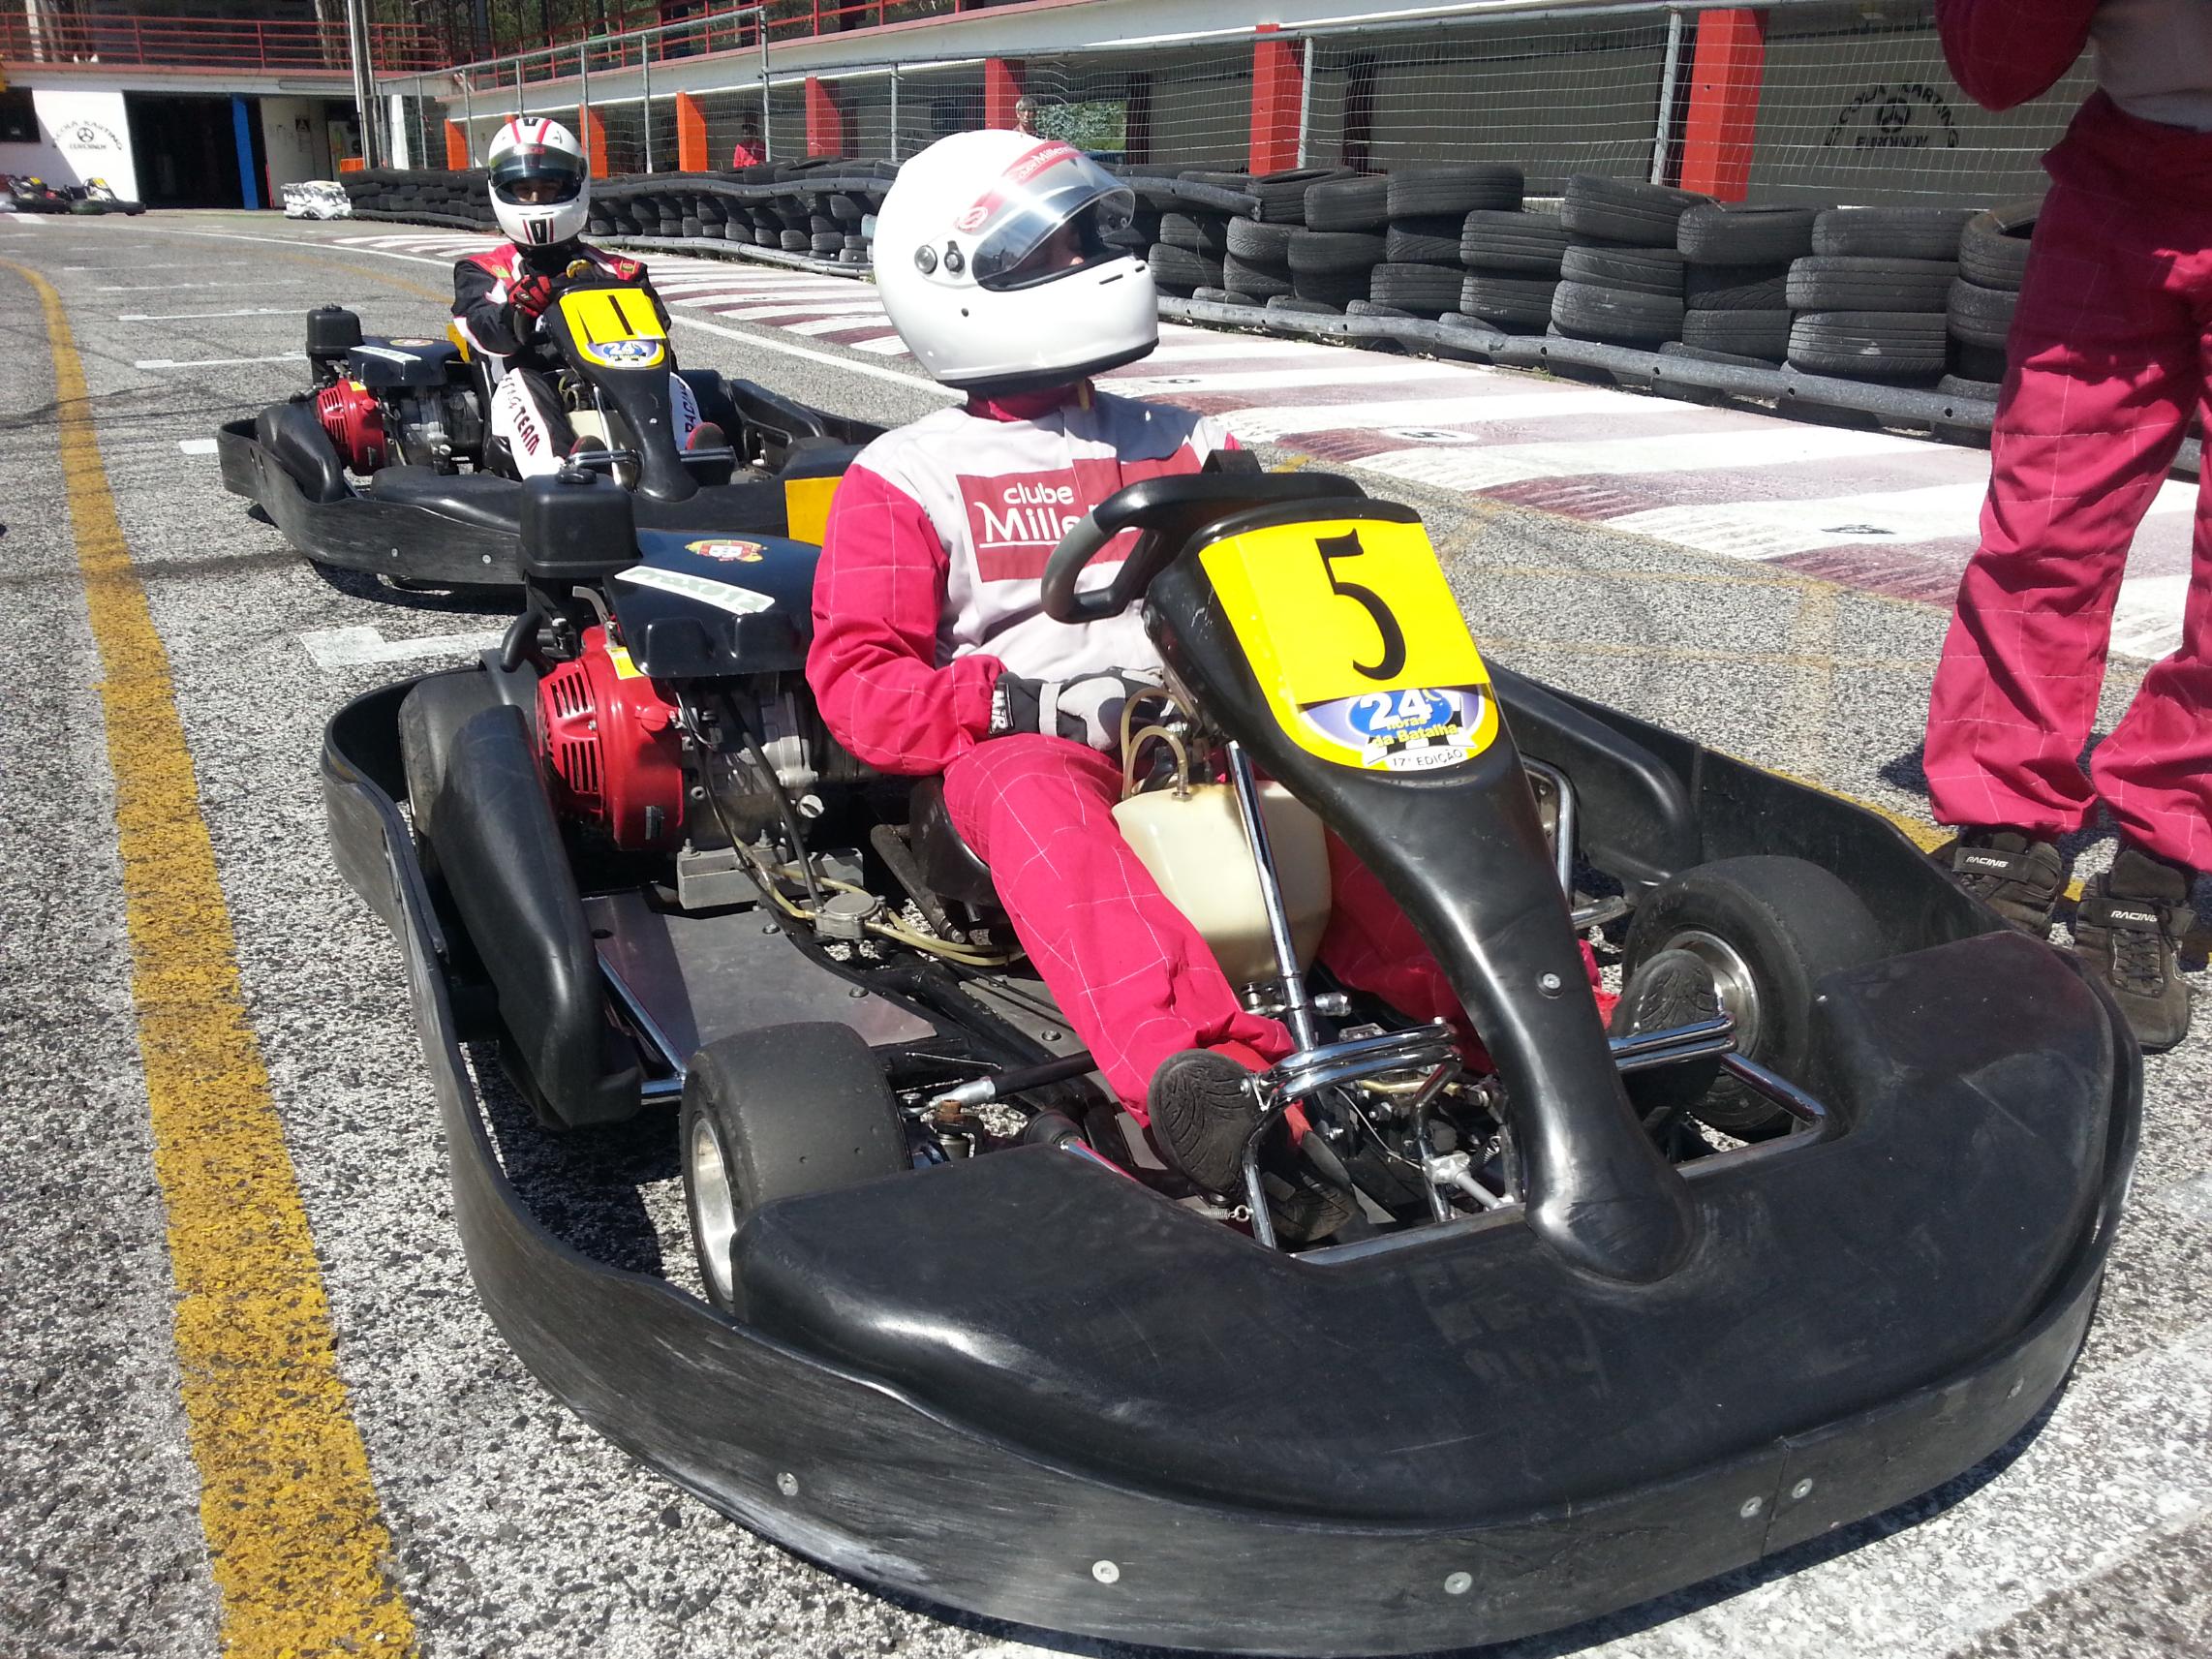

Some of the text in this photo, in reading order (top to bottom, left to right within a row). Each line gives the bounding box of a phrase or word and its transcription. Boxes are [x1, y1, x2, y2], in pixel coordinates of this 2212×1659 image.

[513, 406, 540, 456] TEAM
[1003, 482, 1075, 505] clube
[973, 502, 1098, 543] Mille
[1314, 528, 1406, 681] 5
[1372, 723, 1458, 748] da Batalha
[1416, 748, 1462, 766] EDIÇÃO
[1965, 856, 2010, 869] RACING
[2110, 910, 2159, 923] RACING
